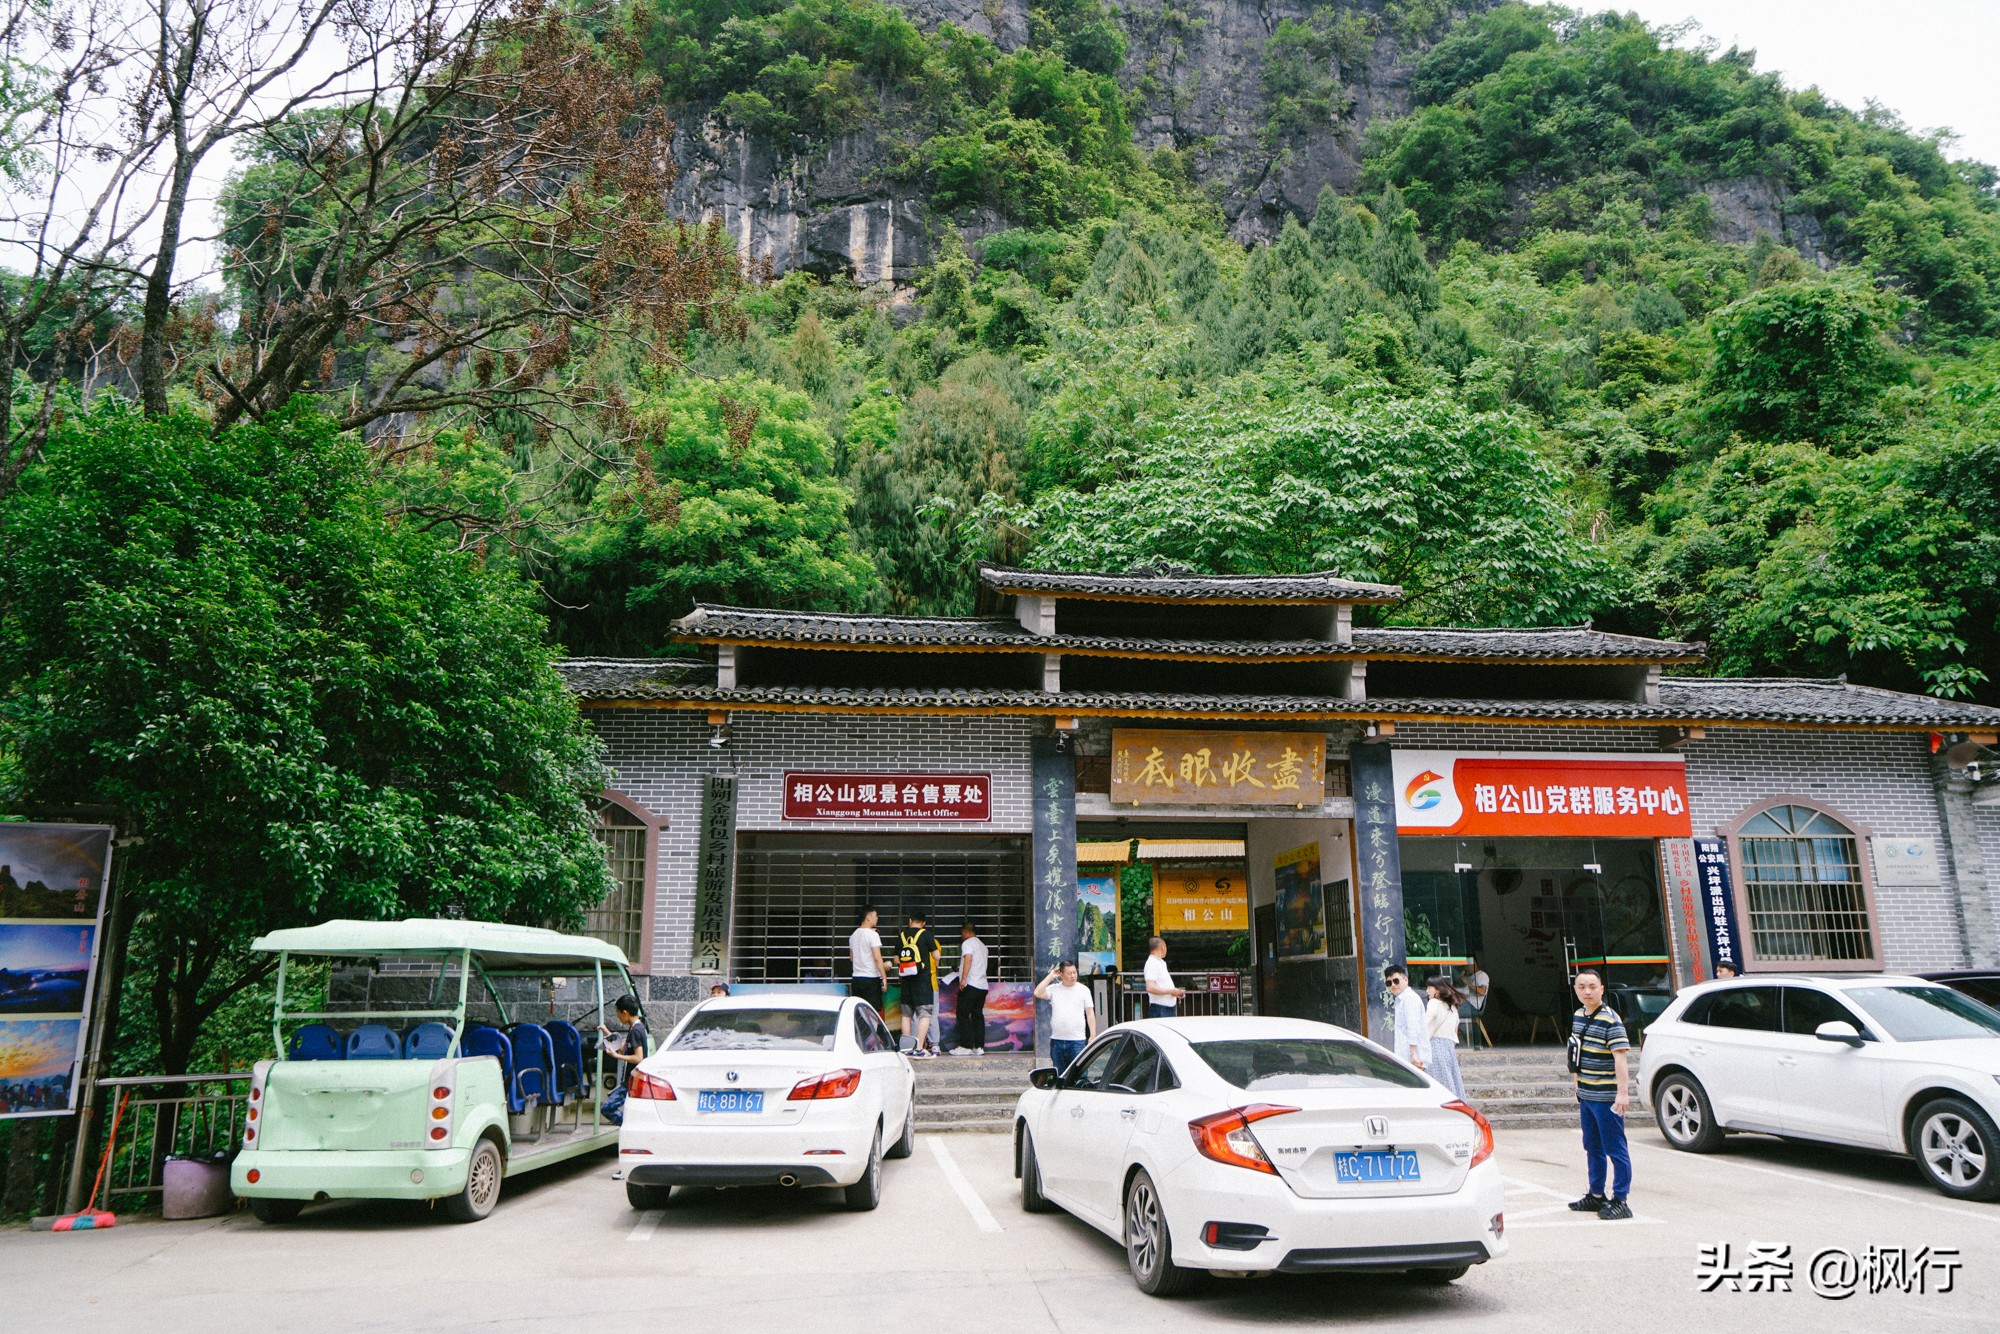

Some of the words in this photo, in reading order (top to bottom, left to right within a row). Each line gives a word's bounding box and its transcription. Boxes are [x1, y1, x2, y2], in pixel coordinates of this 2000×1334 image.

[794, 782, 983, 804] 相公山观景台售票处
[1474, 783, 1684, 816] 相公山党群服务中心
[816, 808, 861, 818] Xianggong
[862, 808, 902, 817] Mountain
[904, 809, 931, 817] Ticket
[933, 809, 959, 817] Office
[1700, 843, 1720, 853] 阳朔
[1698, 854, 1725, 863] 公安局
[700, 777, 732, 970] 阳朔金荷包乡村旅游发展有限公司
[1183, 908, 1233, 921] 相公山
[1706, 865, 1733, 963] 兴坪派出所驻大坪村
